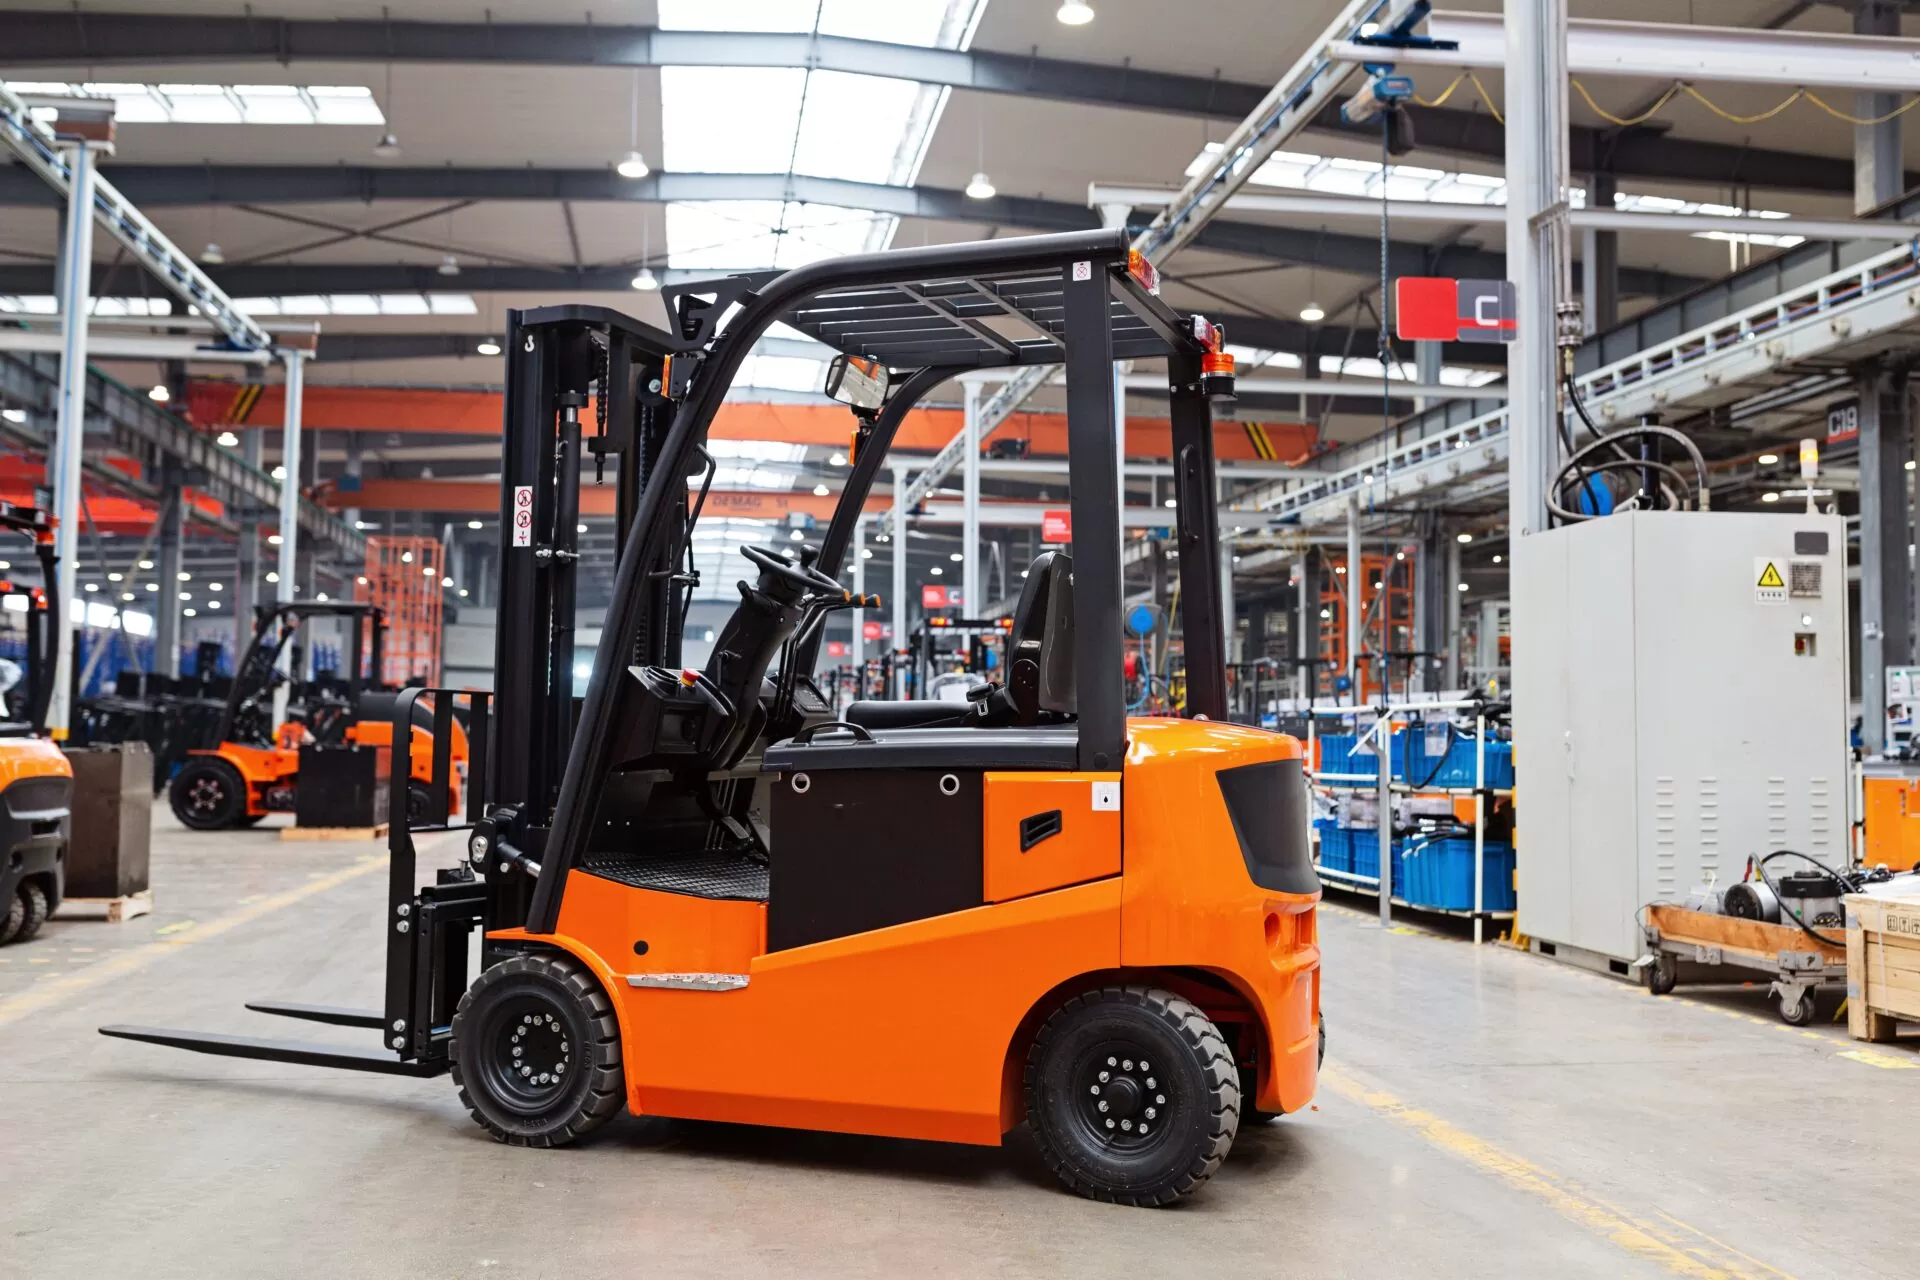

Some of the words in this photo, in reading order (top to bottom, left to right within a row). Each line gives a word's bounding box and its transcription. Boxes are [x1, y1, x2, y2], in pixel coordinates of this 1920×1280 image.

[1475, 295, 1499, 326] C
[1828, 406, 1858, 436] C19
[712, 495, 762, 508] DEMAG
